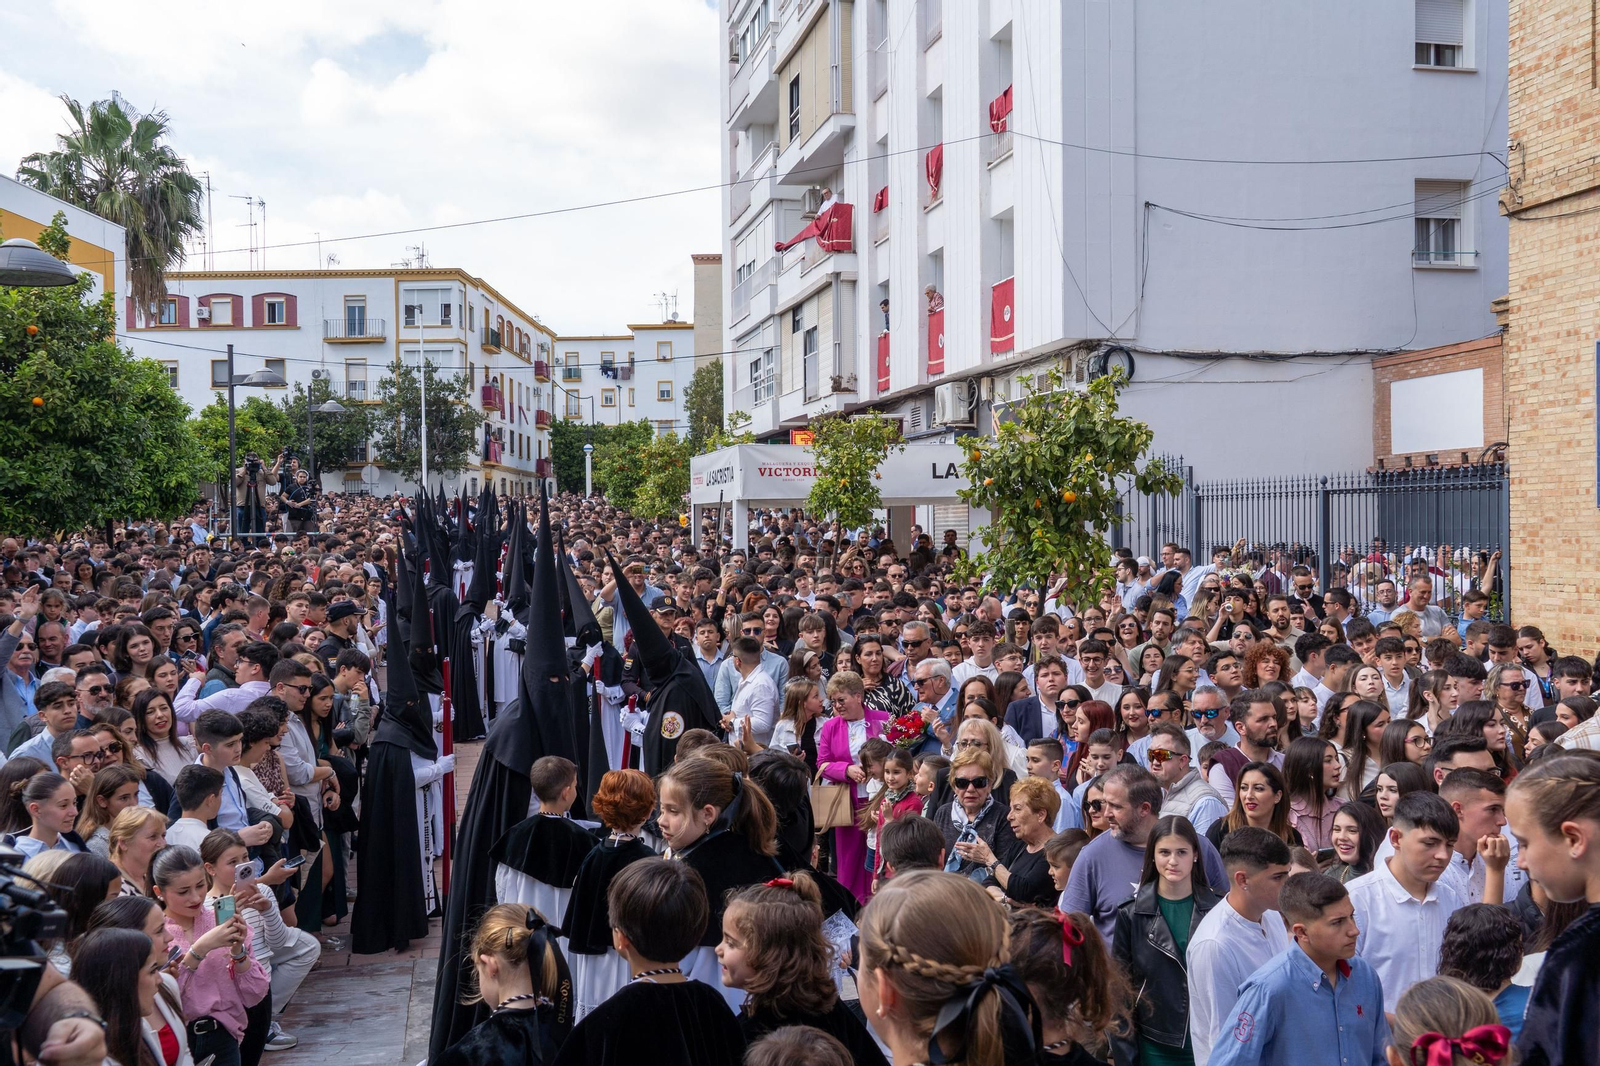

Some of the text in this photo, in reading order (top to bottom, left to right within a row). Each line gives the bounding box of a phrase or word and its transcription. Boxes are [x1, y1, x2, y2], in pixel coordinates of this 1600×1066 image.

[932, 463, 959, 479] LA
[557, 979, 570, 1024] Rosario
[1234, 1011, 1255, 1043] 3
